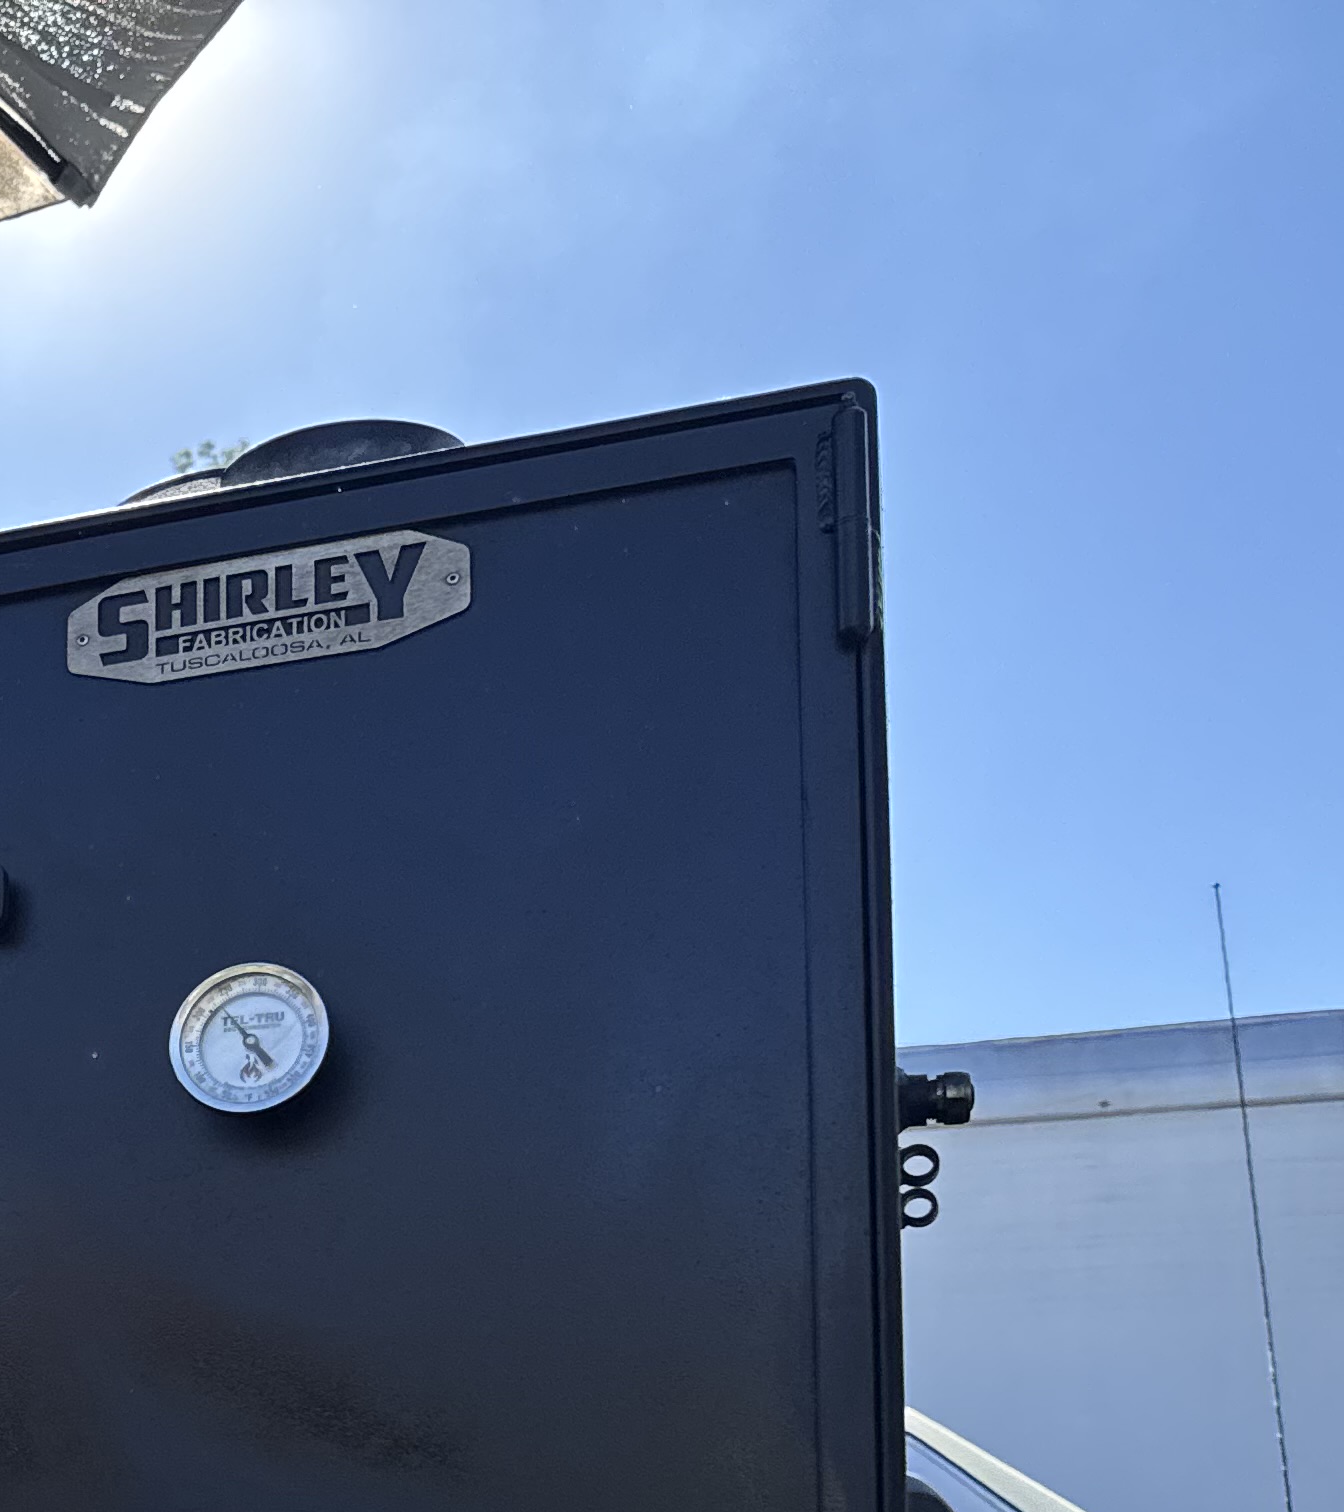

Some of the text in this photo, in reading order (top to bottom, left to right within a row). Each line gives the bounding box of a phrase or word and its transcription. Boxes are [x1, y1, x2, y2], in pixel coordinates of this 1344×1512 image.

[97, 542, 427, 667] SHIRLEY
[155, 630, 372, 675] TUSCALOOSA, AL
[177, 609, 346, 653] FABRICATION
